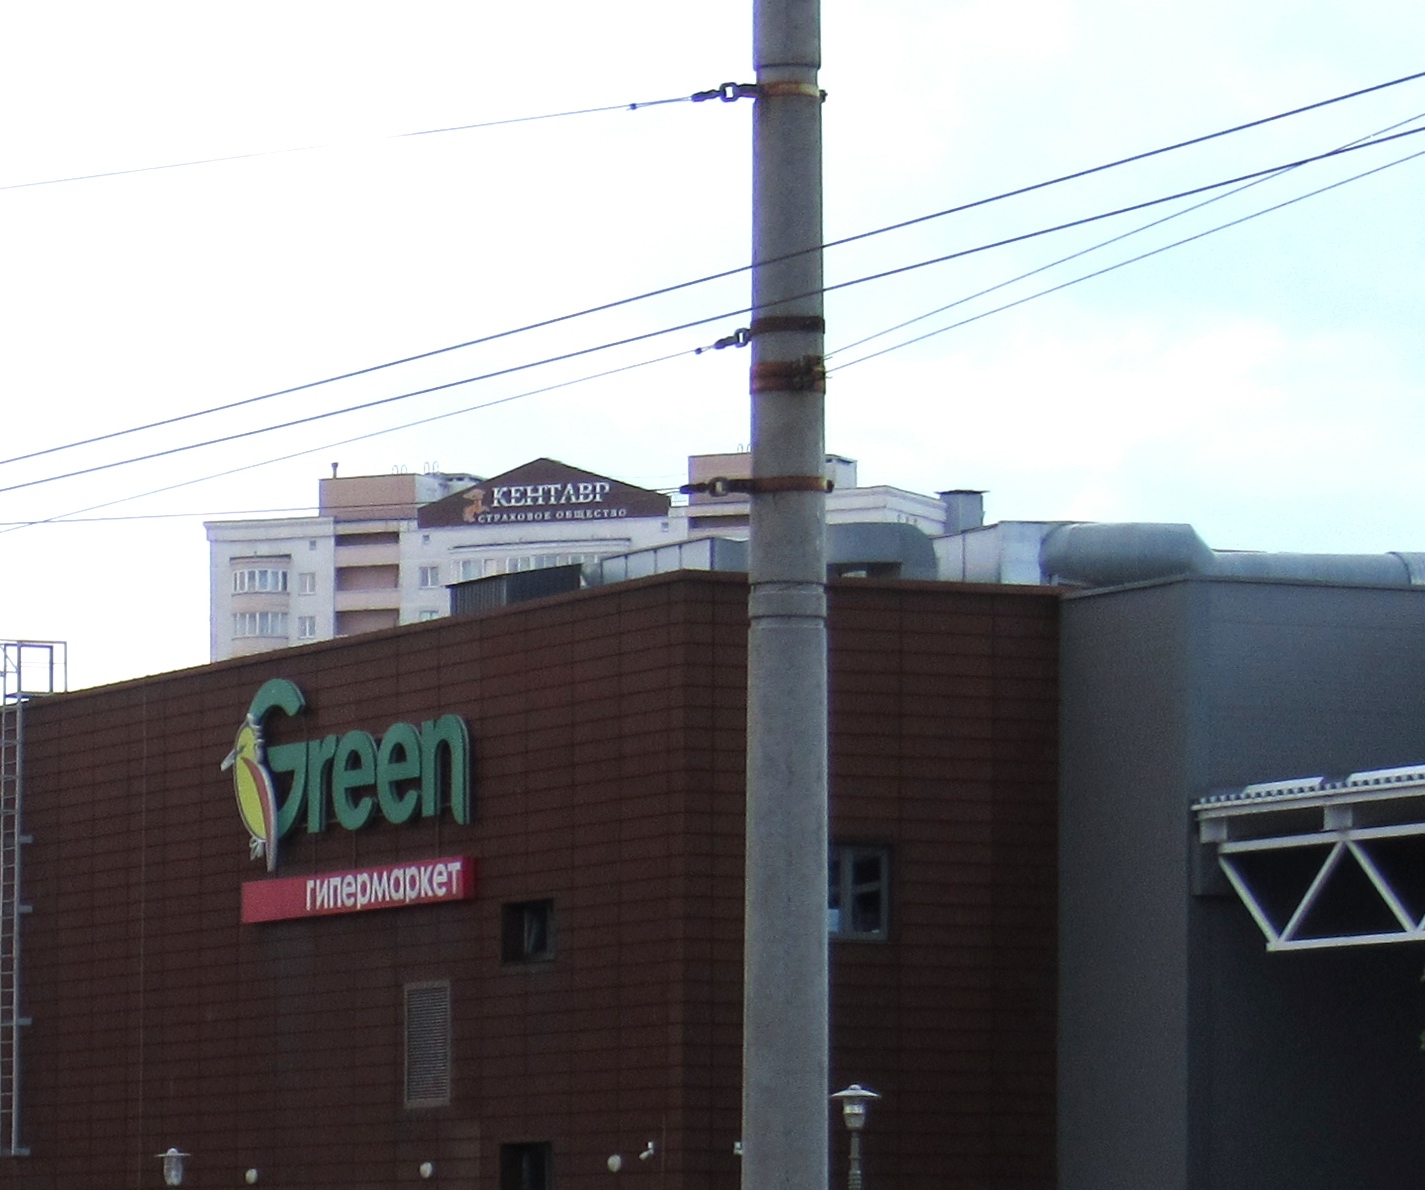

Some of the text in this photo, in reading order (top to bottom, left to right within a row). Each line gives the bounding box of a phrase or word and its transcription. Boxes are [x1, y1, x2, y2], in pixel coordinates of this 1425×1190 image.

[491, 482, 610, 508] КЕНТАВР
[478, 508, 627, 524] СТРАХОВОЕ ОБЩЕСТВО
[235, 678, 471, 840] Green
[306, 861, 462, 910] гипермаркет
